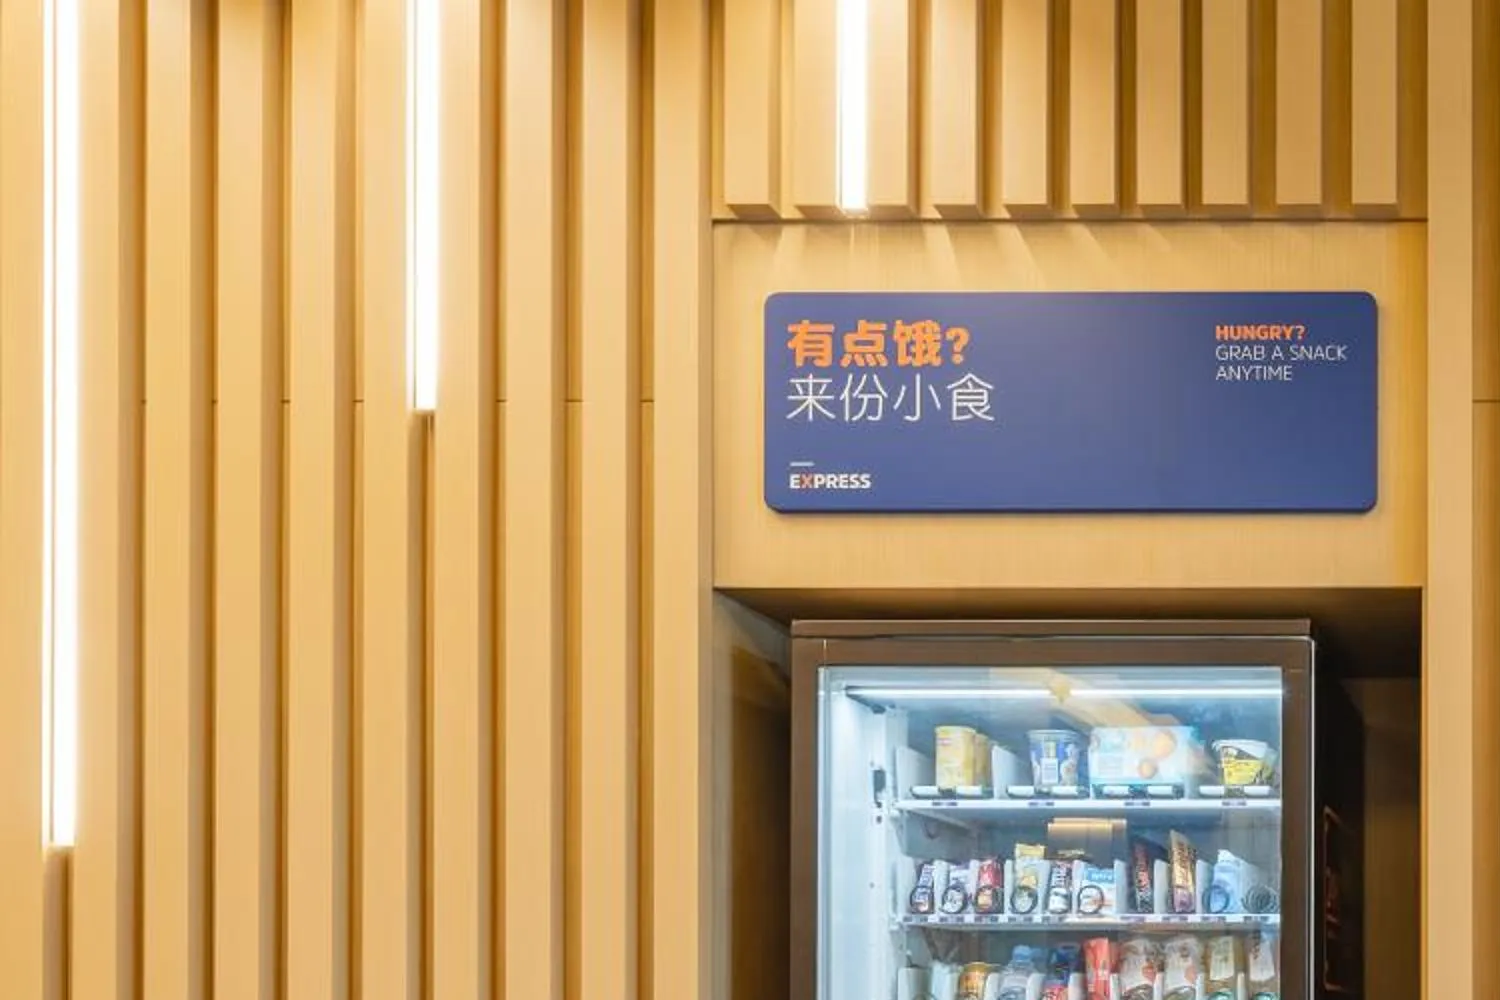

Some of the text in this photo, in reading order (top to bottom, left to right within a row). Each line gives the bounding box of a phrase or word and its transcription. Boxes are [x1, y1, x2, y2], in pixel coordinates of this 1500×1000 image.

[1215, 325, 1305, 341] HUNGRY?
[786, 318, 970, 368] 有点饿?
[1215, 345, 1348, 361] GRAB A SNACK
[1215, 365, 1293, 381] ANYTIME
[786, 372, 996, 423] 来份小食
[789, 473, 872, 490] EXPRESS
